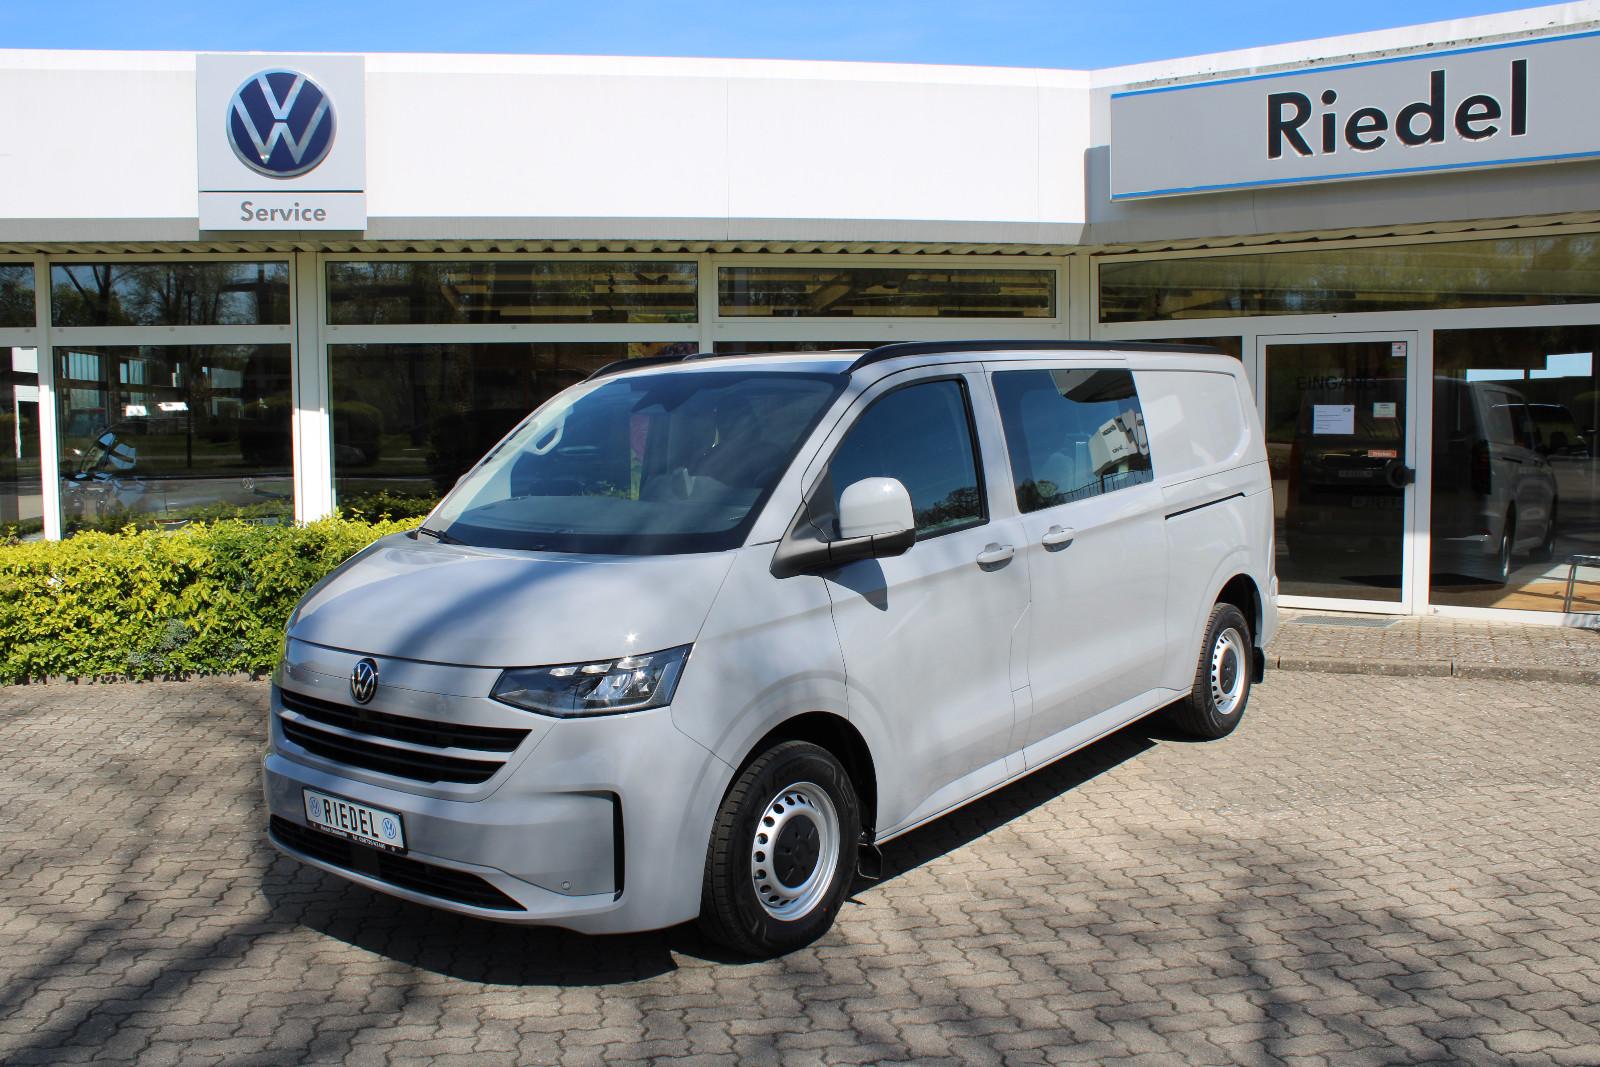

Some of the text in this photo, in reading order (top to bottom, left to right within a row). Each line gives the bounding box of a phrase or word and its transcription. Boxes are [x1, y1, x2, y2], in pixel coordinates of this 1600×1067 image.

[1267, 59, 1527, 160] Riedel
[240, 201, 327, 222] Service
[323, 798, 379, 838] RIEDEL
